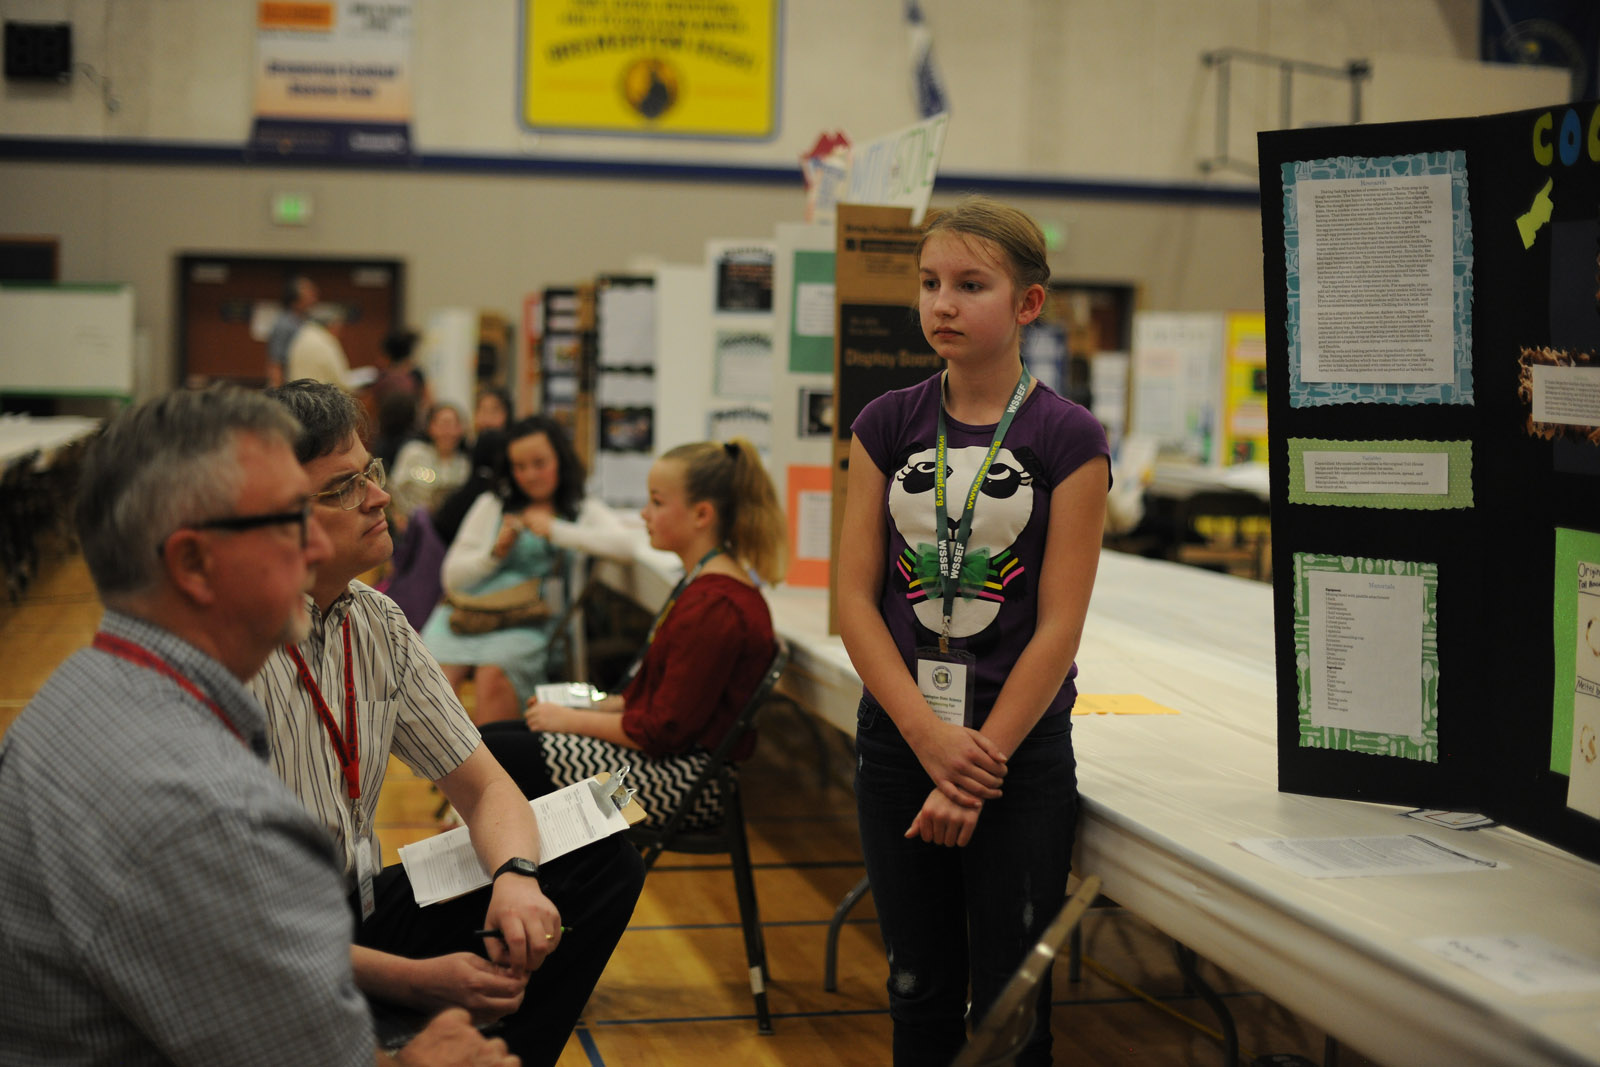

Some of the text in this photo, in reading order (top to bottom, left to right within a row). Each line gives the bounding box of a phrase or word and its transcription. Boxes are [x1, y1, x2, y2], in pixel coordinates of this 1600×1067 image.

[1007, 384, 1026, 413] WSSEF
[936, 436, 944, 506] www.wssef.org
[967, 440, 1001, 510] www.wssef.org
[938, 540, 948, 576] WSSEF
[950, 542, 964, 579] WSSEF
